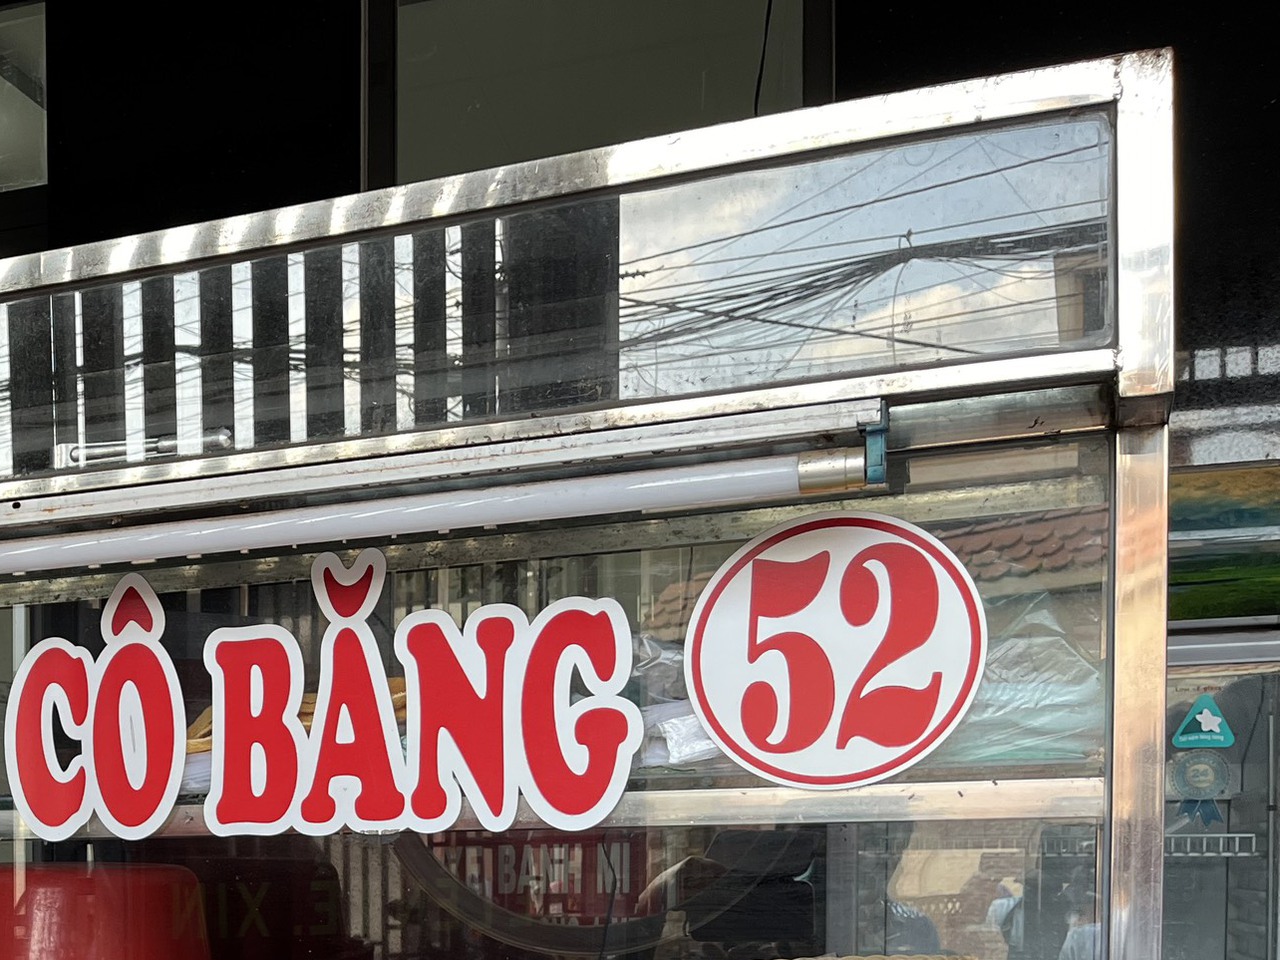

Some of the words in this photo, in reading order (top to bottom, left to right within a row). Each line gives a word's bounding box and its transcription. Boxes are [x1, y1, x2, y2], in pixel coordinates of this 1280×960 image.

[12, 580, 179, 832] CÔ
[211, 558, 634, 828] BĂNG
[738, 540, 943, 756] 52
